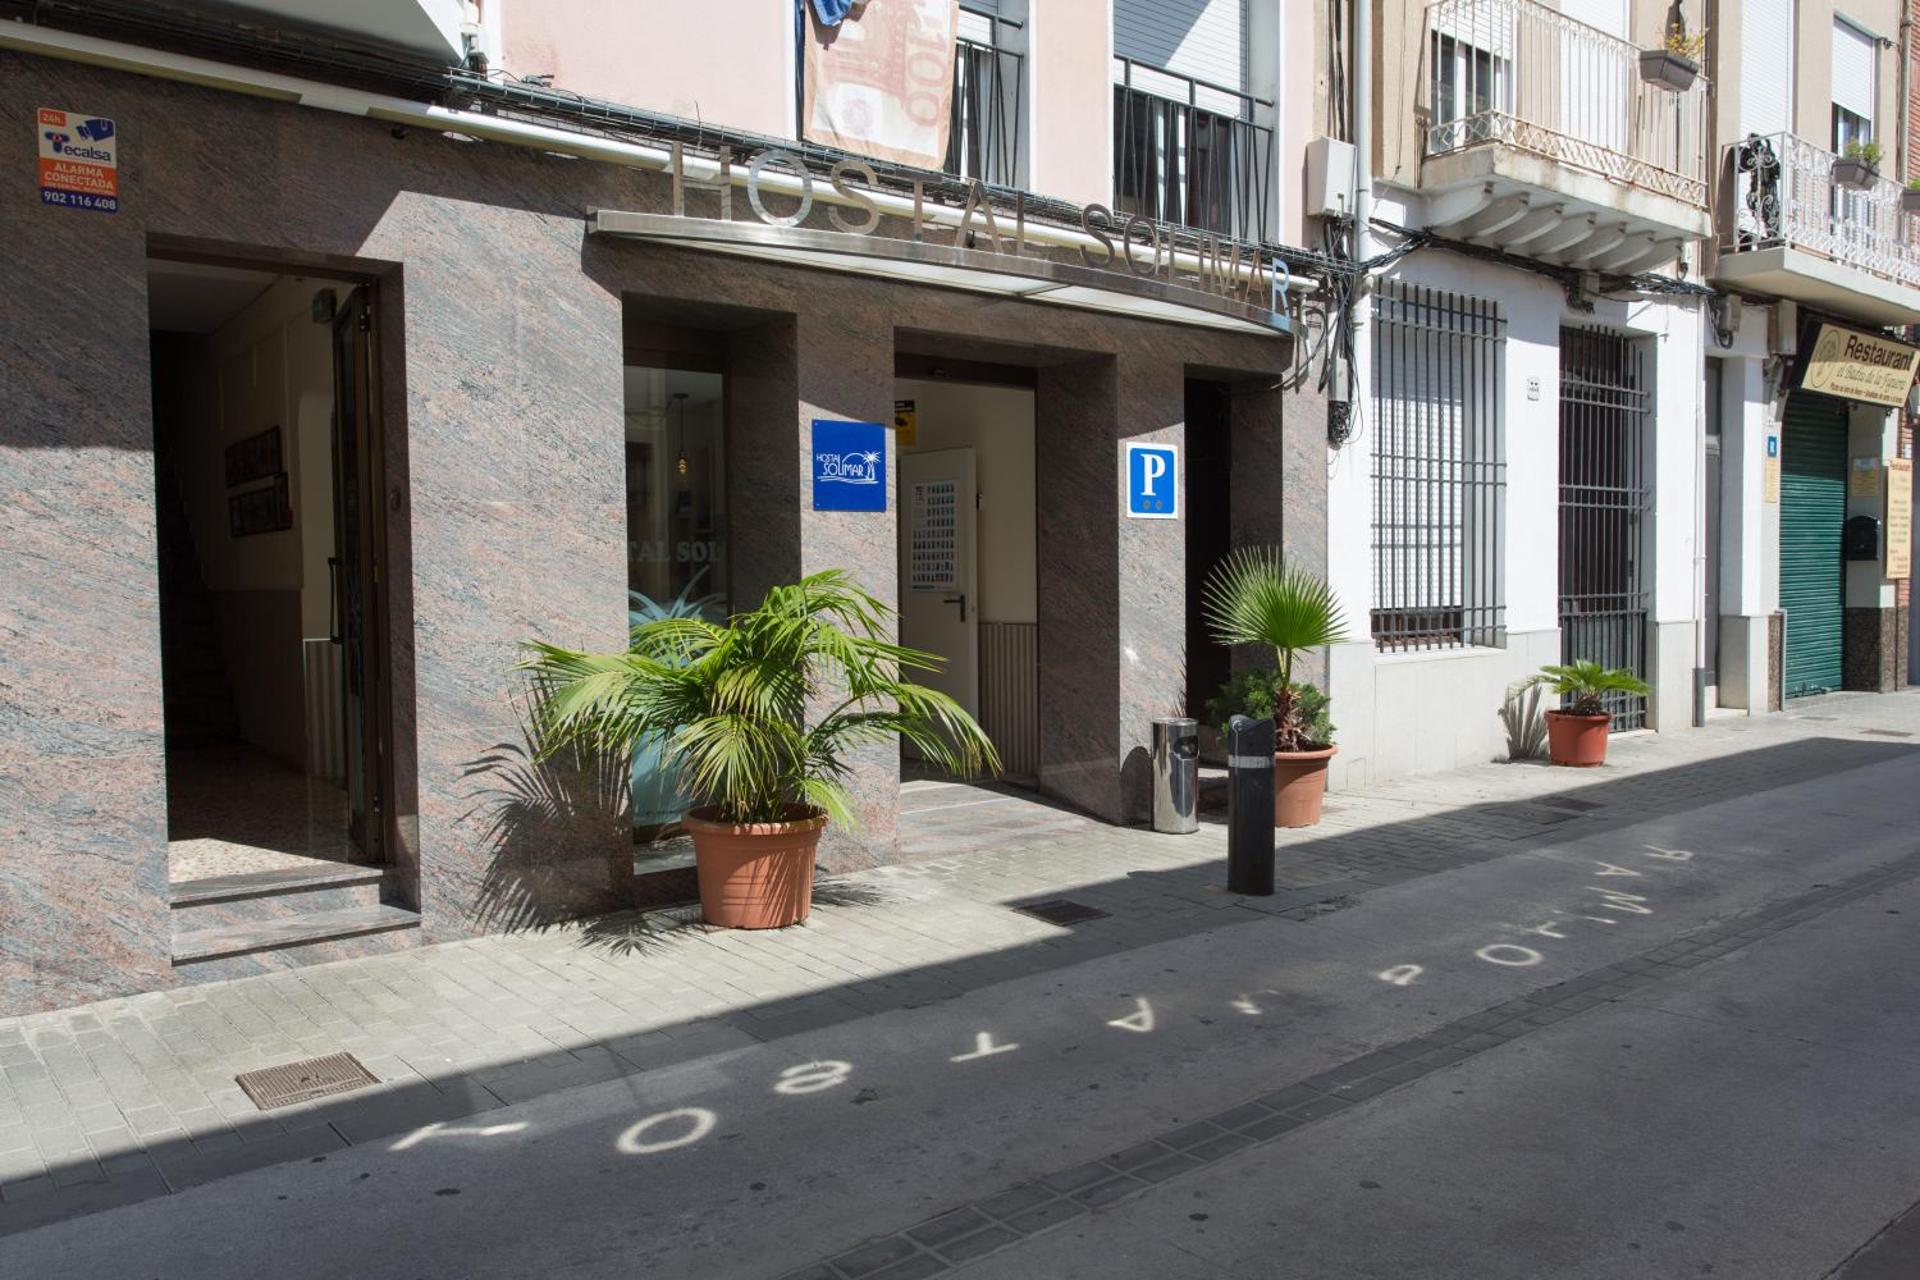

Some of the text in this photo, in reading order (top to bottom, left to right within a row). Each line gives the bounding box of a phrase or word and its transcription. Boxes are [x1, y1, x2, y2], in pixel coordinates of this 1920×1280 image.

[54, 162, 104, 178] ALARMA
[44, 171, 113, 189] CONECTADA
[44, 191, 117, 210] 902 116 408
[672, 140, 1290, 317] HOSTAL SOLIMAR
[1844, 334, 1916, 371] Restaurant
[823, 461, 864, 477] SOLIMAR
[1140, 453, 1165, 496] P
